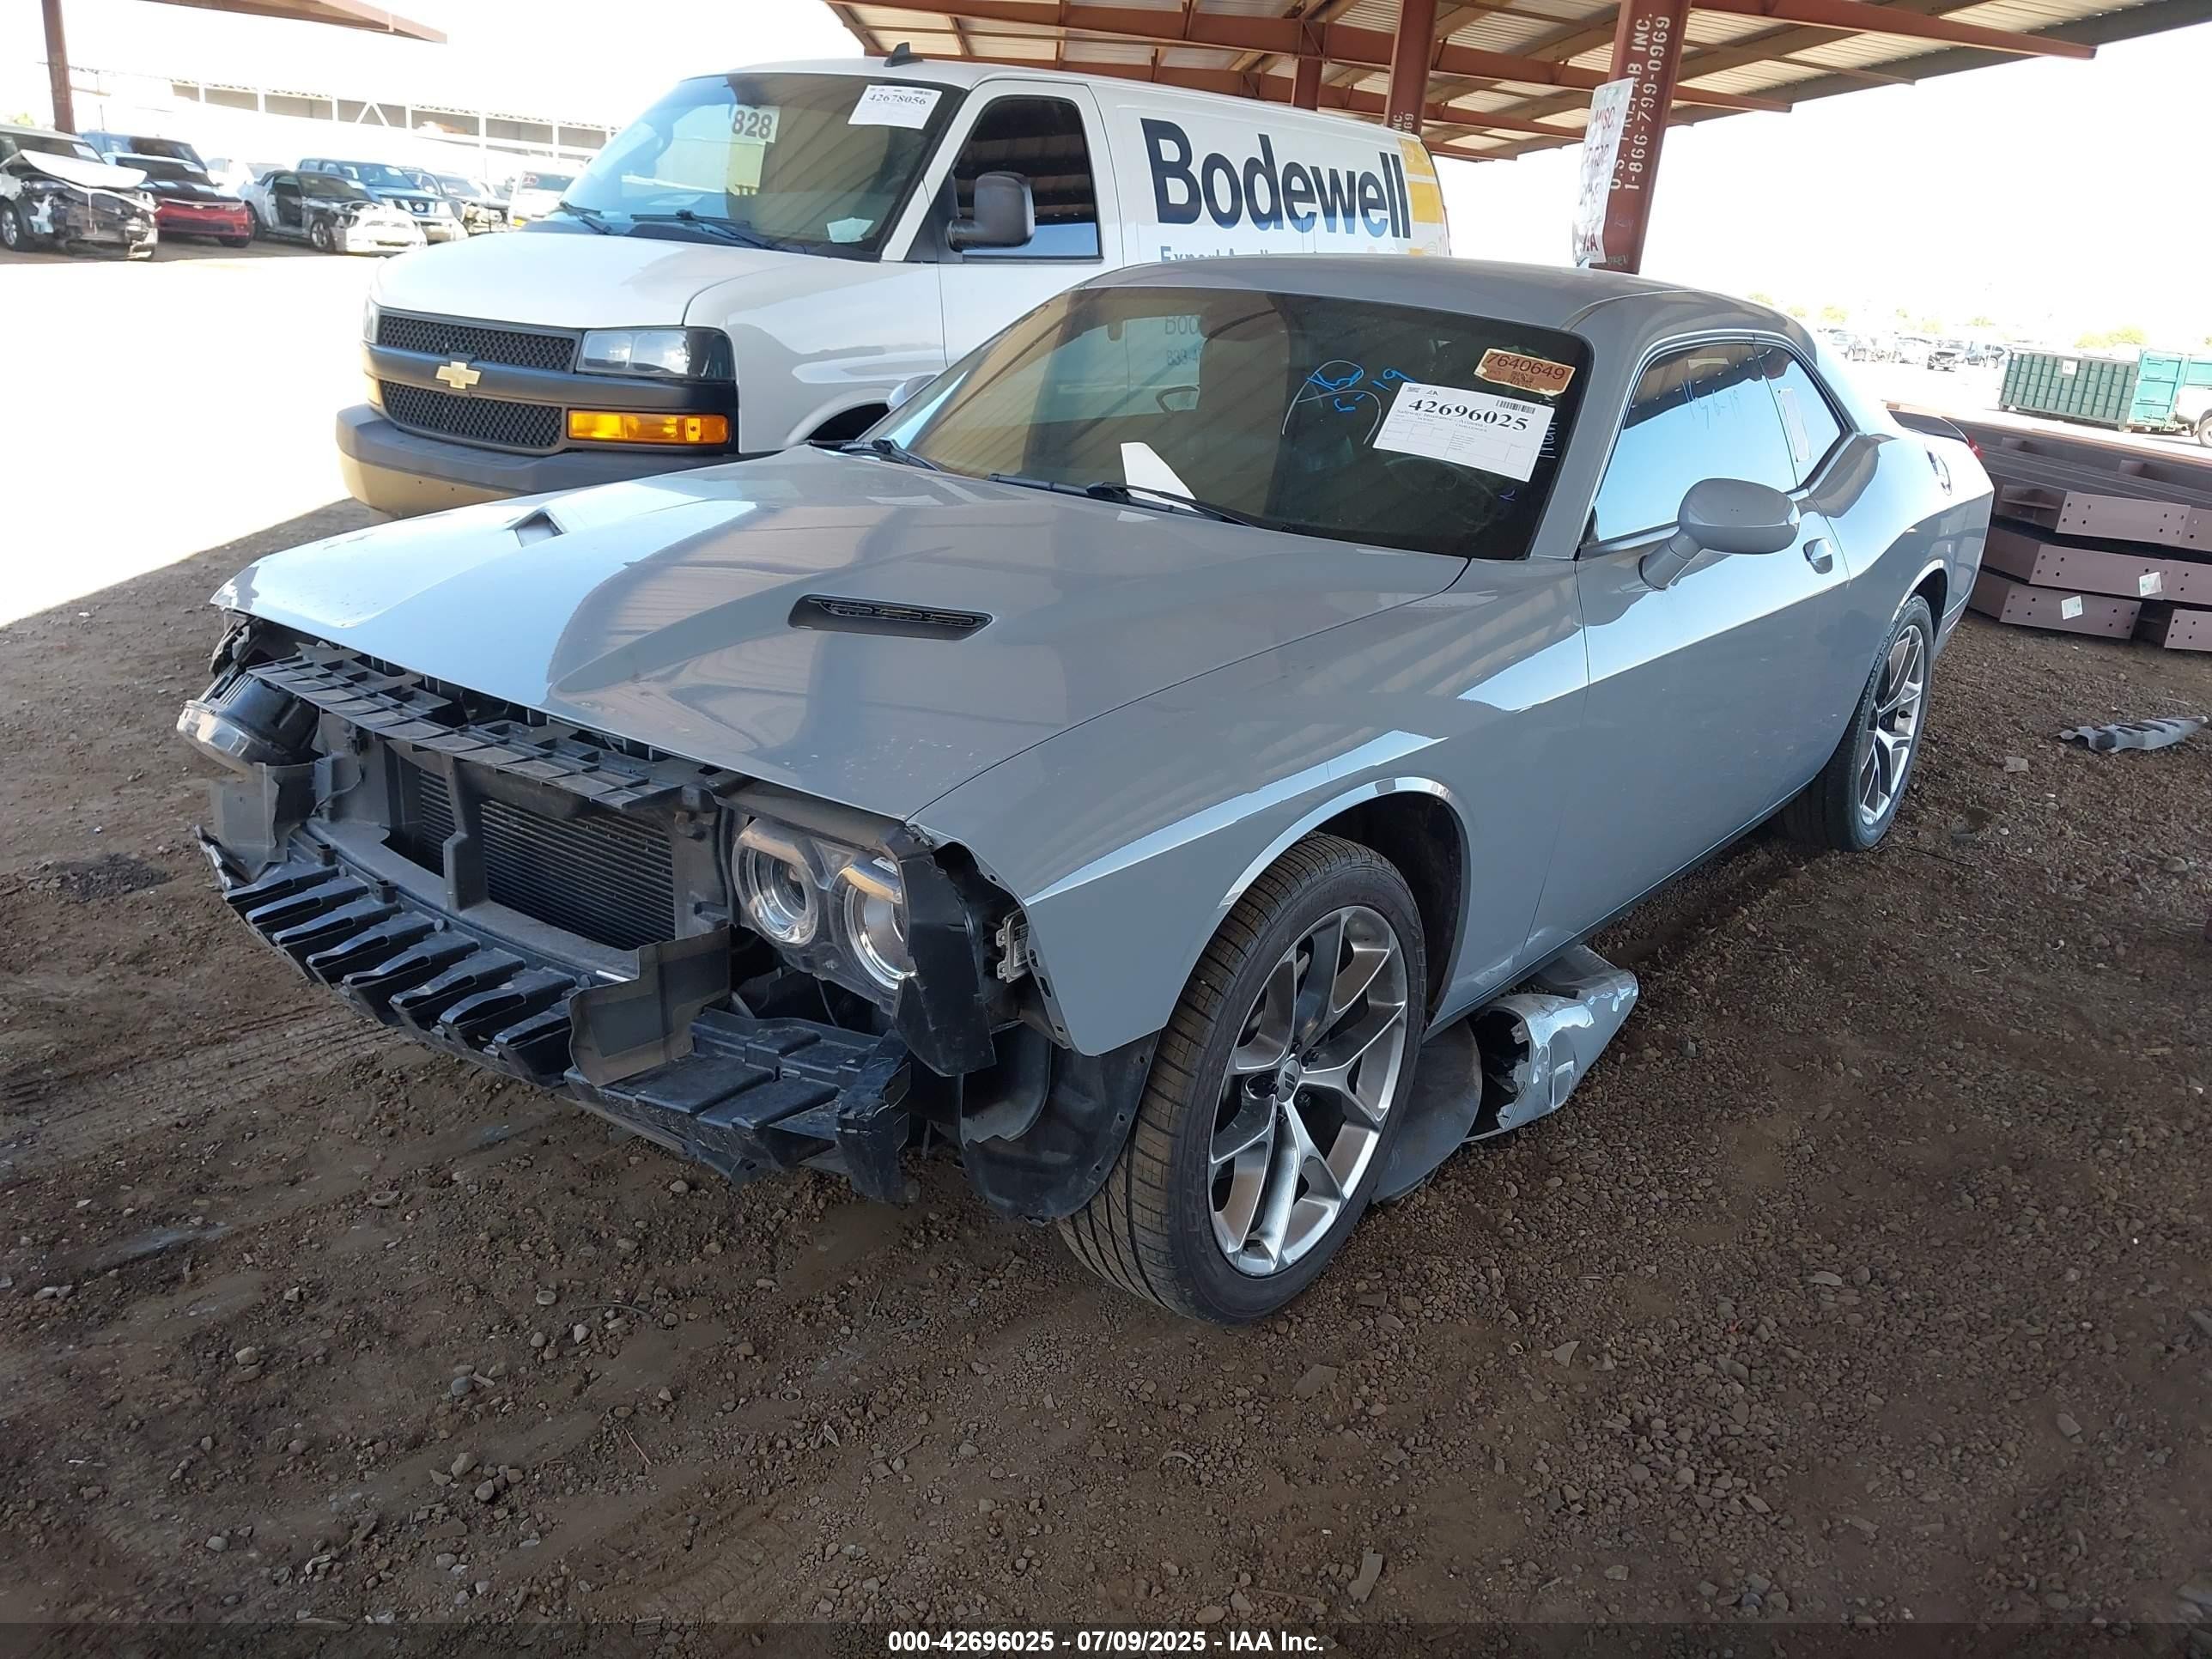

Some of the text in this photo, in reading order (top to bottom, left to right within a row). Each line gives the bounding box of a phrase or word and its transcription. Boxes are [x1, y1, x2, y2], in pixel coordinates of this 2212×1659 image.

[1631, 14, 1653, 52] INC.
[868, 94, 927, 105] 42678056
[1625, 16, 1670, 191] 1-866-799-0969
[732, 110, 773, 139] 828
[1140, 118, 1412, 240] Bodewell
[1486, 352, 1565, 380] 7640649
[1408, 398, 1529, 432] 42696025
